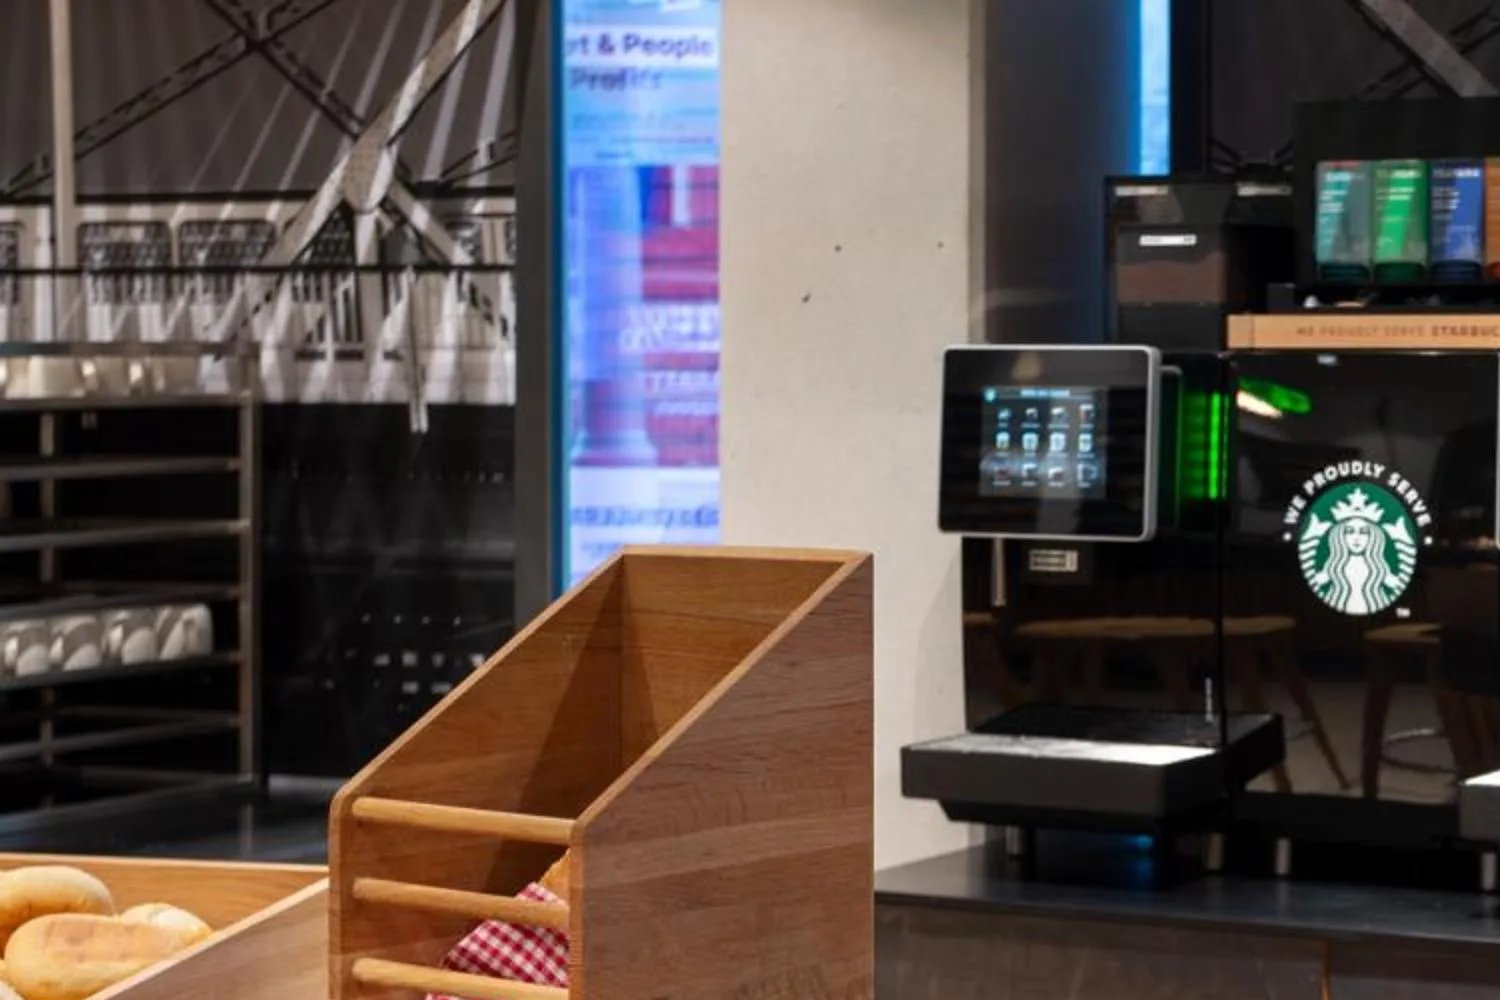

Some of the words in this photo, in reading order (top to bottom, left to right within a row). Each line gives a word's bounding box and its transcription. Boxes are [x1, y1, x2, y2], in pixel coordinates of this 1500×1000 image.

[598, 33, 615, 54] &
[623, 33, 713, 58] People
[1283, 494, 1307, 525] WE
[1302, 460, 1386, 496] PROUDLY
[1387, 471, 1432, 528] SERVE
